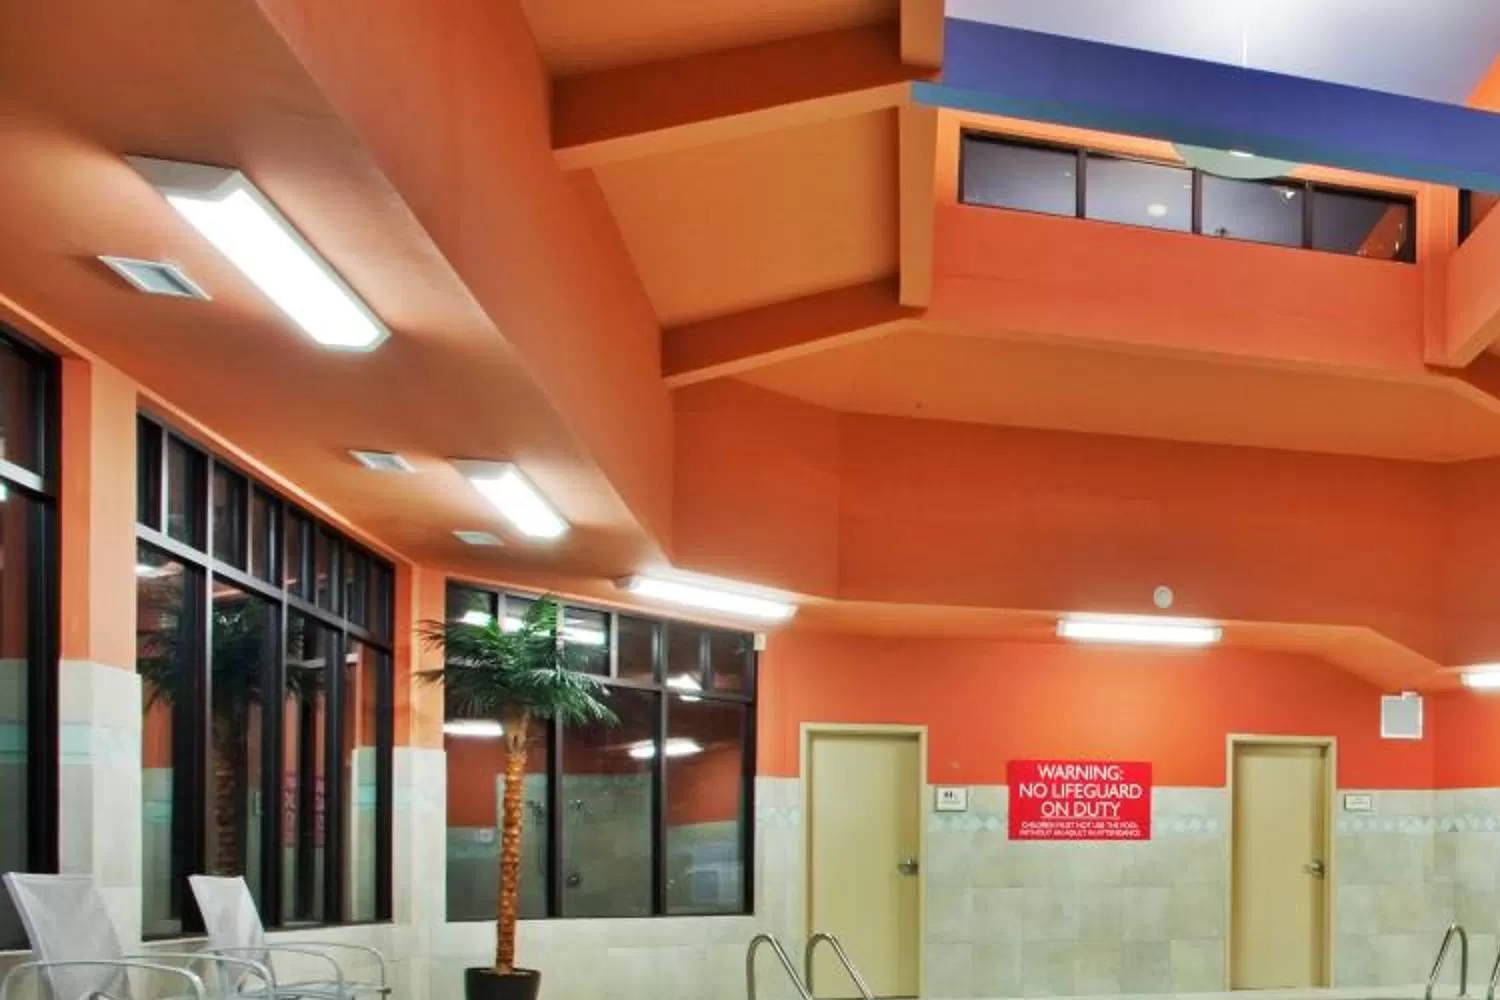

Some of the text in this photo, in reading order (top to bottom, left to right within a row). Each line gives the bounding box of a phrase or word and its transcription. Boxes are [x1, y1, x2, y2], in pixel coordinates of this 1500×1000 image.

[1037, 764, 1123, 780] WARNING:
[1020, 783, 1142, 799] NO LIFEGUARD
[1041, 801, 1120, 816] ON DUTY
